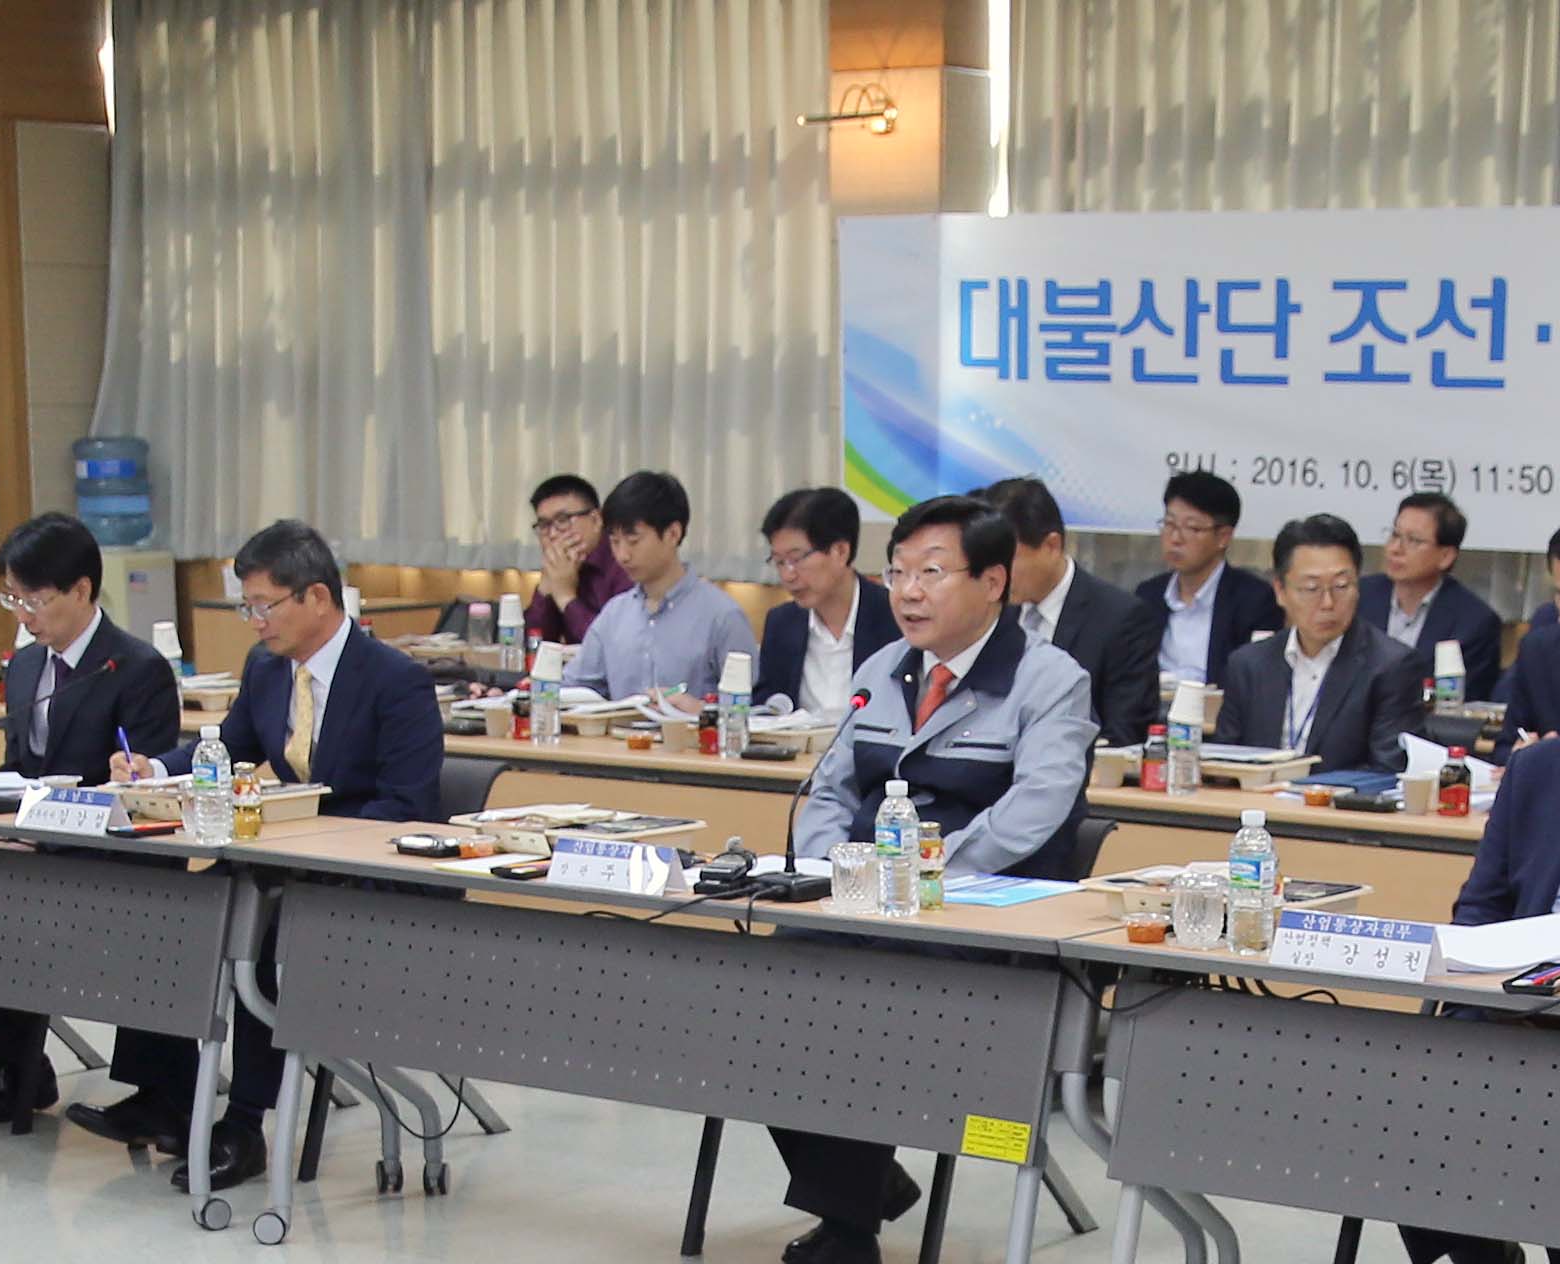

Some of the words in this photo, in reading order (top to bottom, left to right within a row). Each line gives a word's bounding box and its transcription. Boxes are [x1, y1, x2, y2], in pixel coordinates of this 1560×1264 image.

[959, 277, 1301, 386] 대불산단
[1251, 456, 1325, 489] 2016.
[1341, 459, 1379, 490] 10.
[1392, 459, 1457, 494] 6(목)
[1472, 465, 1554, 494] 11:50
[1302, 914, 1412, 940] 산업통상자원부
